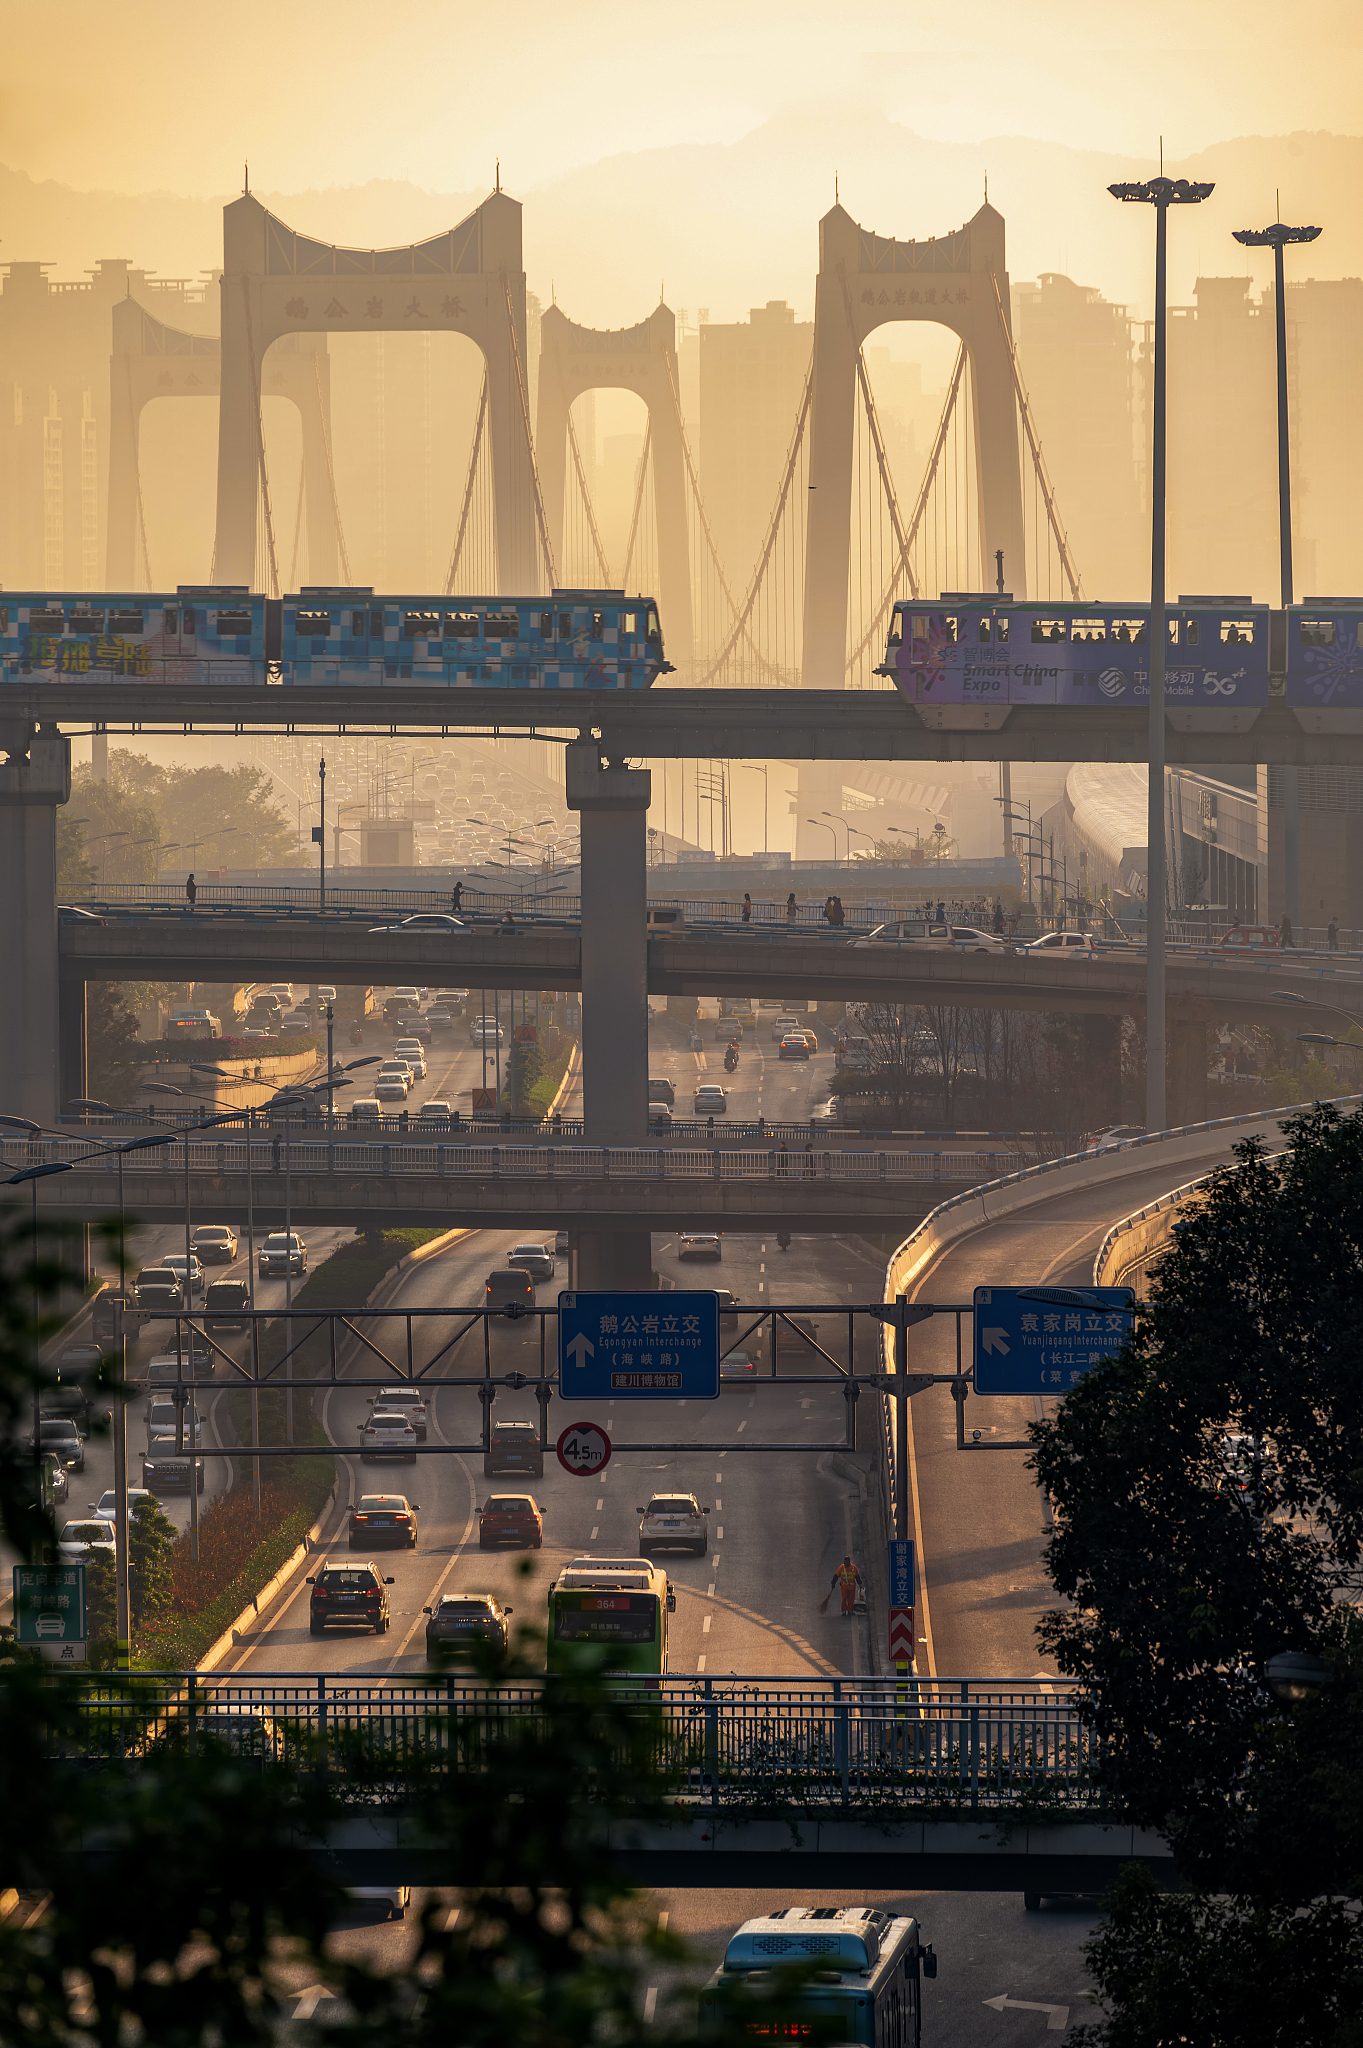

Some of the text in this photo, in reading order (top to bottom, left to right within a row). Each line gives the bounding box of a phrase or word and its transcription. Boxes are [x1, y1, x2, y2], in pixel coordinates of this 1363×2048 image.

[963, 646, 1011, 662] 智博会
[963, 663, 1059, 678] Smart China
[1133, 670, 1195, 685] 中移动
[963, 677, 1001, 693] Expo
[1164, 685, 1195, 695] Mobile
[599, 1314, 701, 1335] 鹅公岩立交
[1020, 1312, 1124, 1333] 袁家岗立交
[599, 1336, 702, 1349] Egongyan Interchange
[1022, 1334, 1123, 1348] Yuanjiagang Interchange
[615, 1374, 679, 1387] 建川博物馆
[563, 1438, 602, 1460] 4.5m
[21, 1571, 77, 1586] 定向车道
[894, 1542, 908, 1604] 谢家湾立交
[29, 1594, 71, 1609] 海峡路
[596, 1599, 616, 1609] 364
